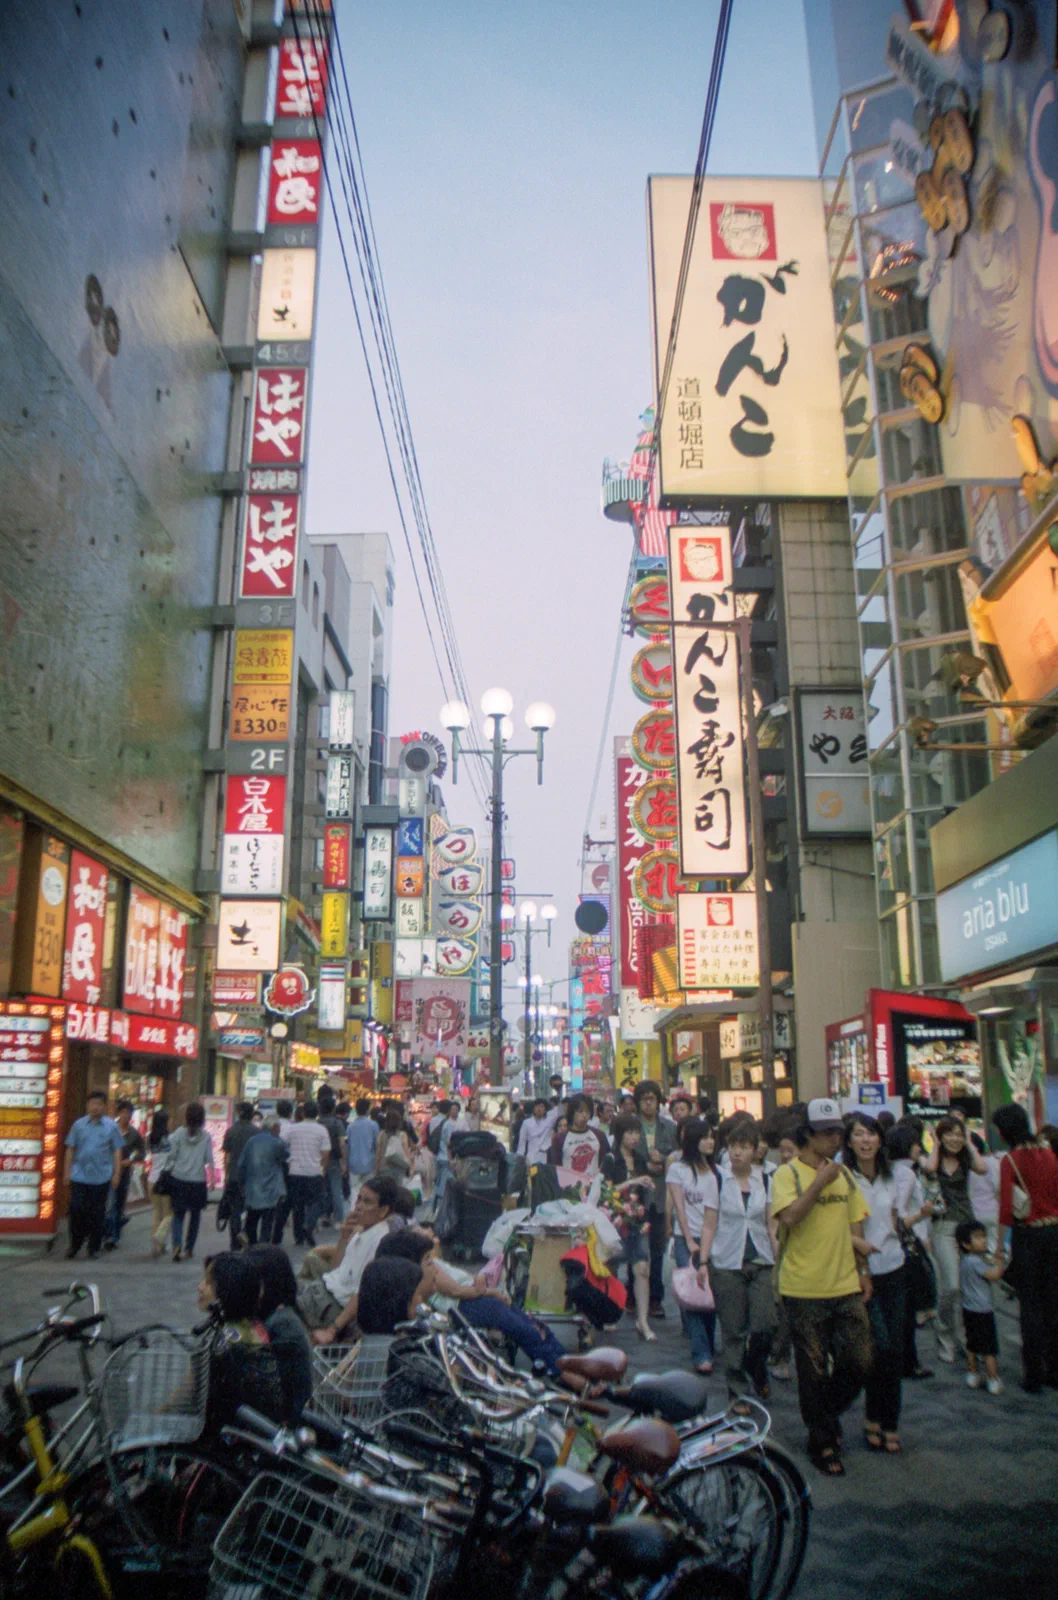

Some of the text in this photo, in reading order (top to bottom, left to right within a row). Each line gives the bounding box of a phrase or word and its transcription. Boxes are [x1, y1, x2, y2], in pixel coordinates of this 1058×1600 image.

[715, 258, 799, 458] がんこ
[255, 373, 302, 457] はや
[676, 376, 704, 470] 道頓堀店
[251, 470, 298, 490] 焼肉
[246, 500, 296, 589] はや
[259, 604, 292, 623] 3F
[243, 717, 278, 735] 330
[684, 584, 736, 851] がんこ寿司
[250, 748, 285, 770] 2F
[238, 776, 273, 832] 白木屋
[627, 897, 644, 927] BIG
[962, 879, 1030, 940] aria blu
[66, 1003, 110, 1043] 白木屋
